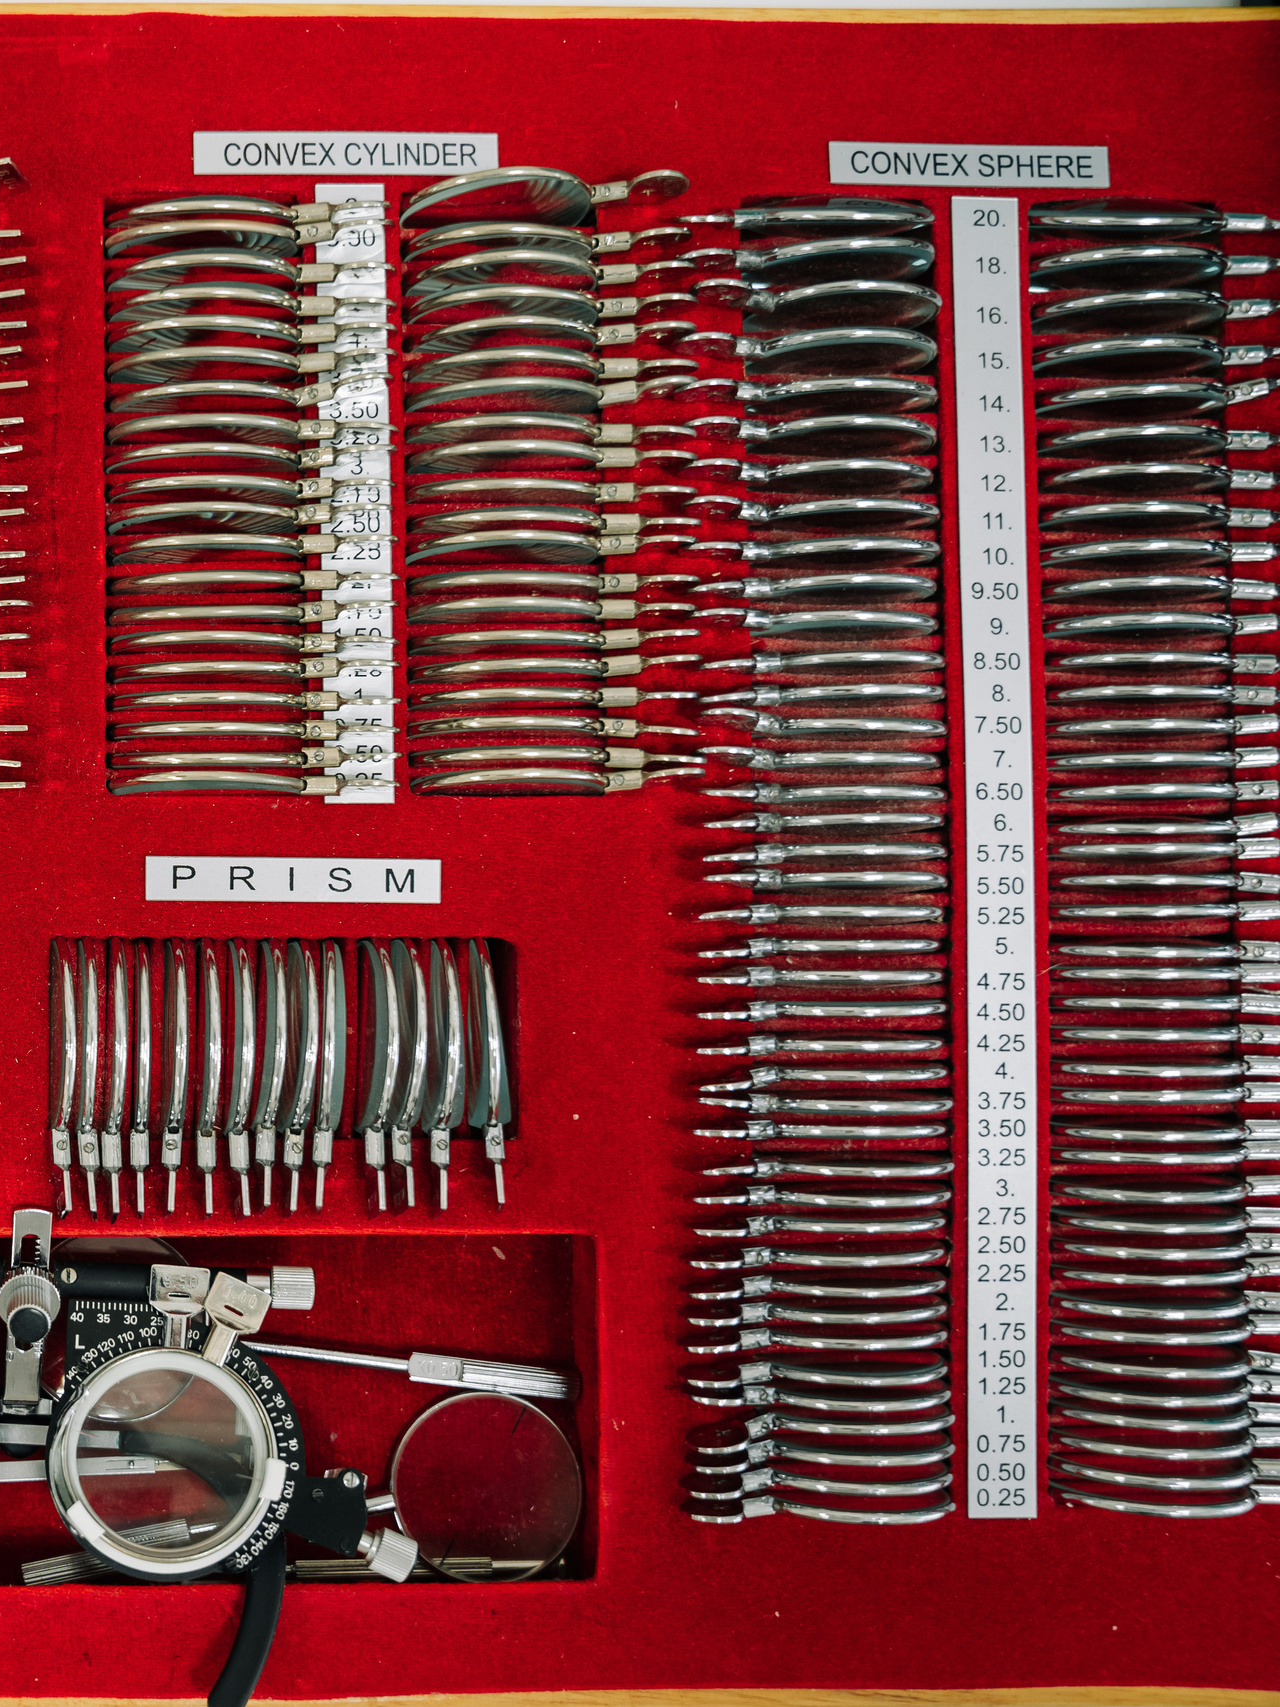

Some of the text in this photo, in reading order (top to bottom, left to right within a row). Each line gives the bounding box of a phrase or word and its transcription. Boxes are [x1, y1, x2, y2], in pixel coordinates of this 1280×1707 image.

[223, 142, 478, 167] CONVEX CYLINDER
[850, 150, 1094, 179] CONVEX SPHERE
[329, 401, 379, 419] 3.50
[970, 581, 1019, 601] 9.50
[973, 651, 1021, 671] 8.50
[974, 715, 1023, 735] 7.50
[975, 781, 1024, 801] 6.50
[976, 844, 1025, 863] 5.75
[976, 876, 1025, 896] 5.50
[976, 906, 1026, 926] 5.25
[976, 972, 1026, 991] 4.75
[975, 1002, 1026, 1022] 4.50
[976, 1033, 1026, 1053] 4.25
[977, 1091, 1027, 1111] 3.75
[977, 1118, 1027, 1138] 3.50
[977, 1147, 1026, 1167] 3.25
[977, 1206, 1027, 1226] 2.75
[977, 1235, 1027, 1255] 2.50
[977, 1263, 1027, 1283] 2.25
[70, 1311, 164, 1326] 40 35 30 25
[74, 1334, 86, 1350] L
[97, 1326, 158, 1353] 120 110 100
[978, 1322, 1027, 1342] 1.75
[978, 1349, 1026, 1369] 1.50
[260, 1375, 274, 1389] 40
[978, 1376, 1027, 1396] 1.25
[272, 1393, 286, 1408] 30
[281, 1413, 294, 1429] 20
[288, 1437, 299, 1451] 10
[976, 1433, 1026, 1454] 0.75
[976, 1462, 1026, 1482] 0.50
[283, 1480, 295, 1499] 170
[976, 1487, 1026, 1507] 0.25
[275, 1501, 290, 1520] 160
